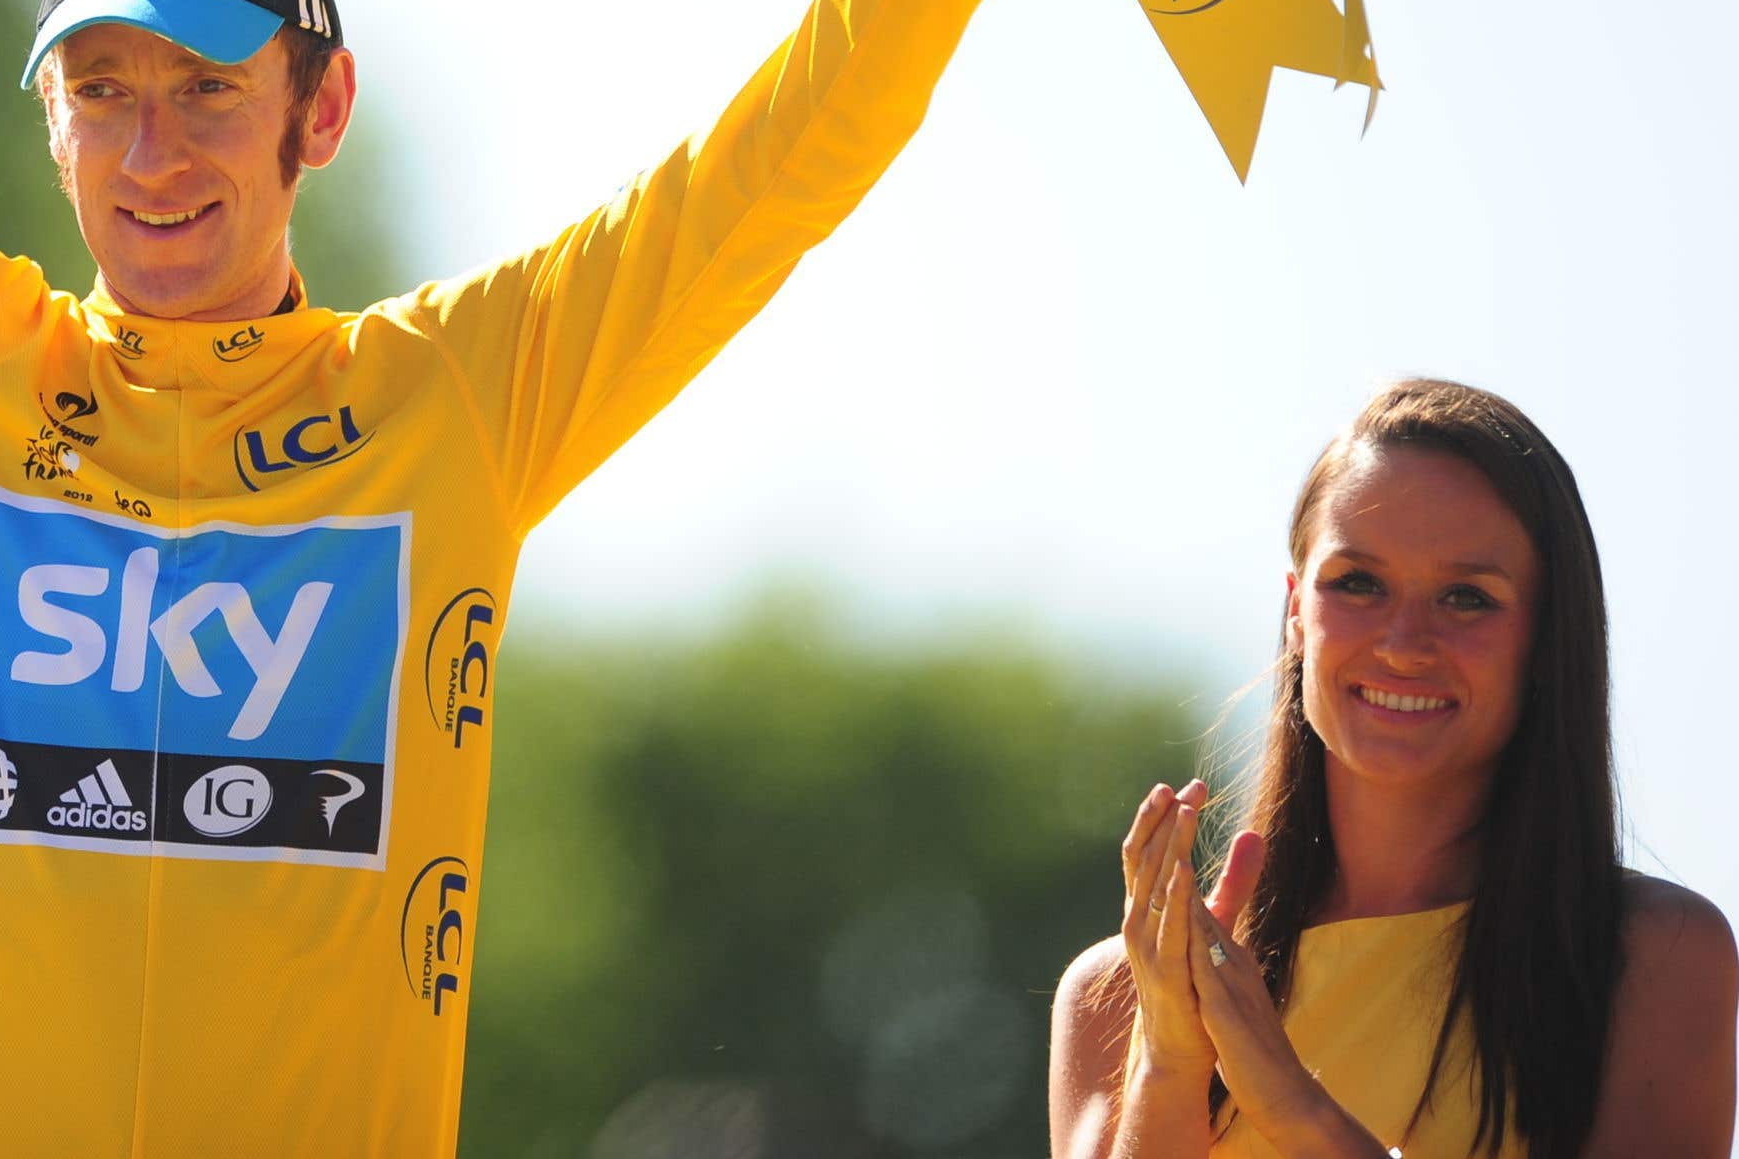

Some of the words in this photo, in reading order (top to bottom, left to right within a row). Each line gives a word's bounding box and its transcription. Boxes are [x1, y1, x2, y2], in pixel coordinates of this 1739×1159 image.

[117, 326, 146, 353] LCL
[216, 325, 265, 353] LCL
[63, 490, 93, 503] 2012
[11, 546, 334, 740] sky
[445, 657, 459, 733] BANQUE
[454, 604, 494, 749] LCL
[47, 803, 147, 832] adidas
[202, 777, 256, 820] IG
[421, 924, 435, 1001] BANQUE
[433, 872, 468, 1017] LCL
